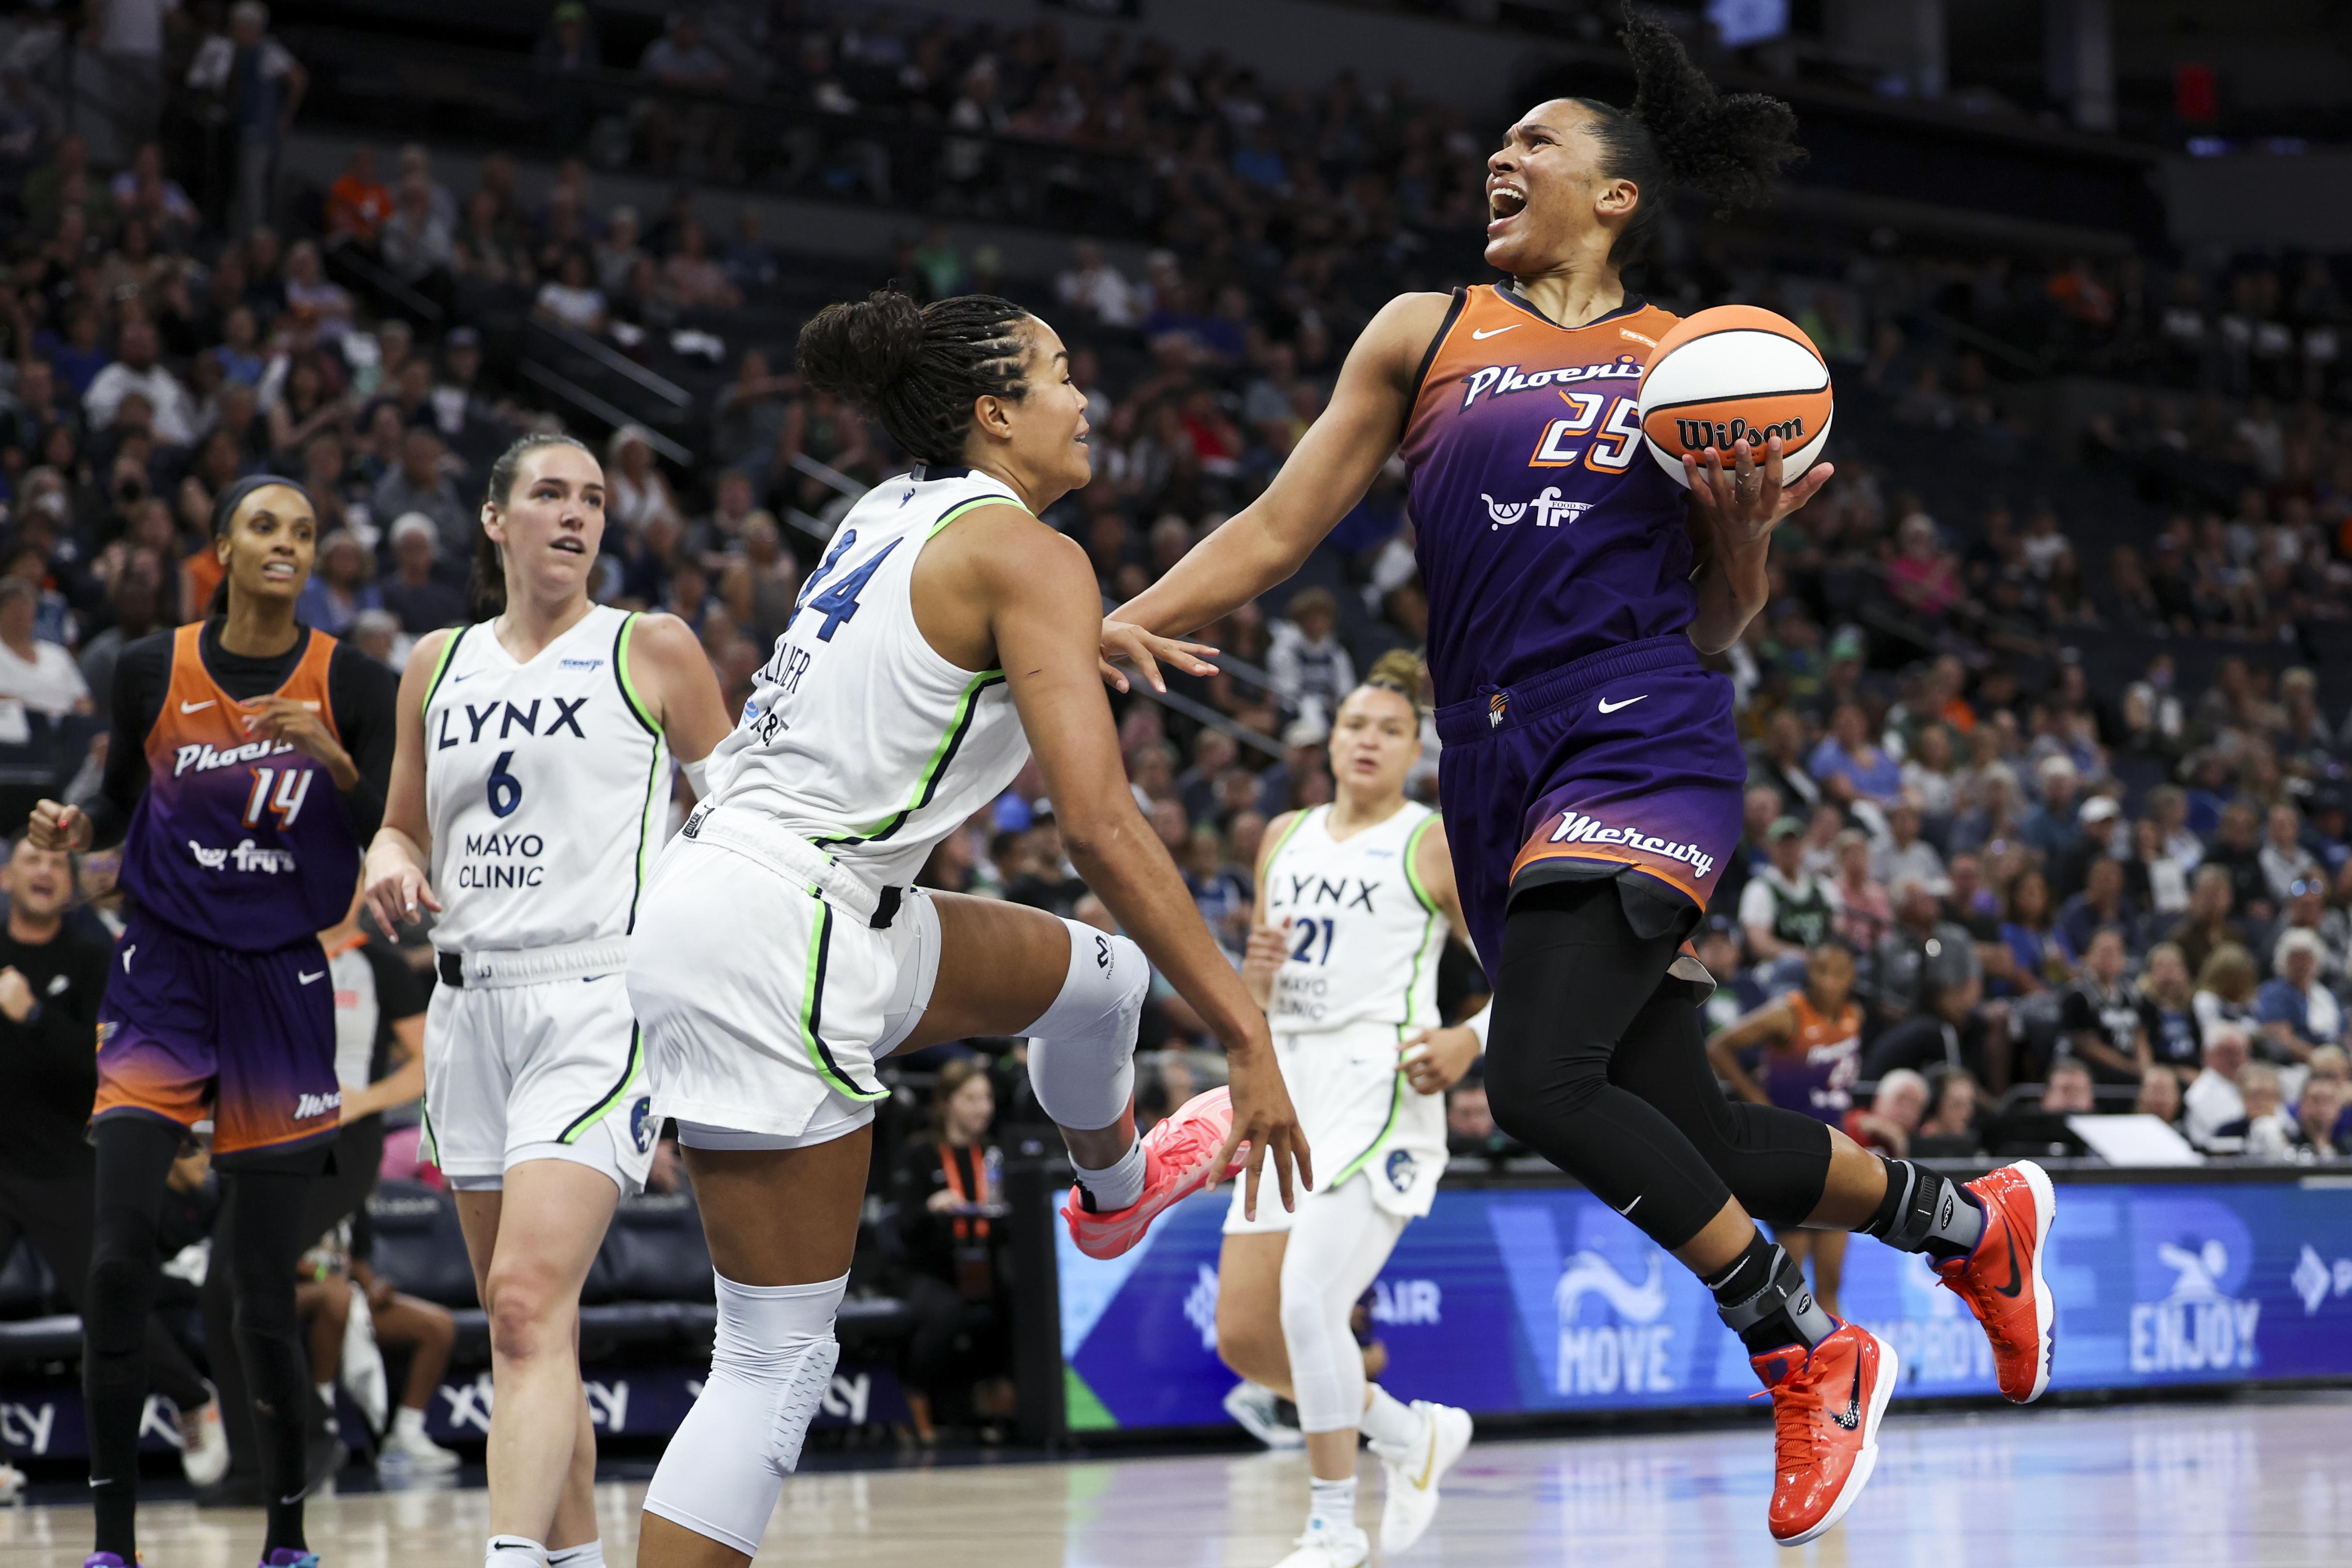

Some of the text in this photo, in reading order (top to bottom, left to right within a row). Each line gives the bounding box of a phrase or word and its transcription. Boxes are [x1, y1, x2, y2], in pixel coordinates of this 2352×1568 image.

[1528, 389, 1643, 475] 25
[1675, 417, 1805, 451] Wilson
[438, 697, 590, 751] LYNX
[241, 768, 314, 831] 14
[488, 751, 522, 818] 6
[466, 834, 543, 857] MAYO
[1551, 811, 1714, 879] Mercury
[460, 865, 544, 888] CLINIC
[1272, 873, 1381, 913] LYNX
[1292, 918, 1335, 966] 21
[1556, 1325, 1675, 1395] MOVE
[2129, 1299, 2259, 1373] ENJOY
